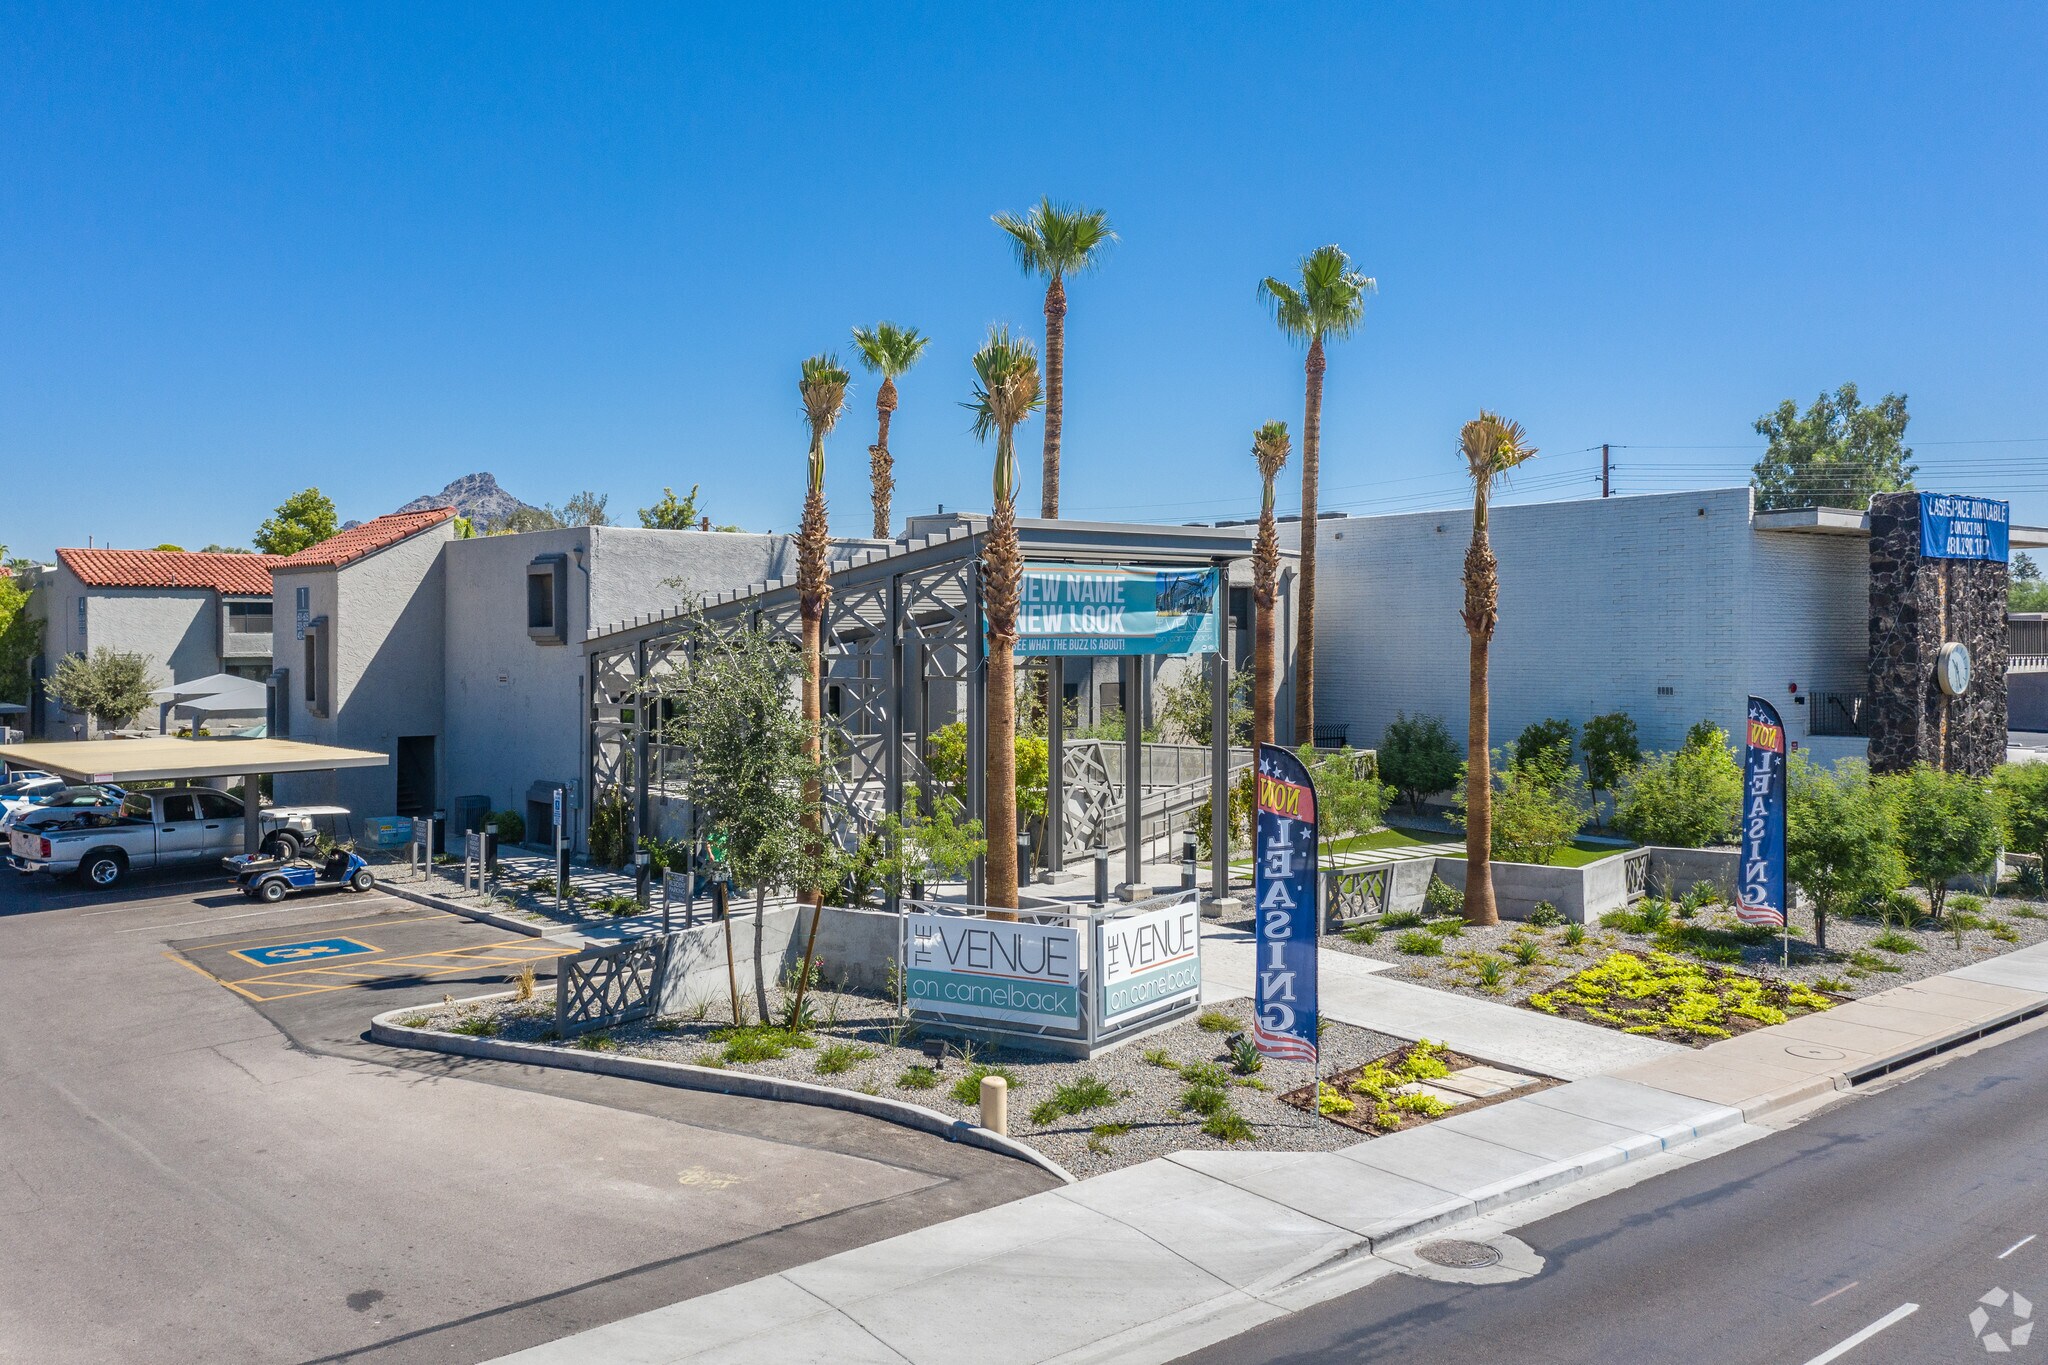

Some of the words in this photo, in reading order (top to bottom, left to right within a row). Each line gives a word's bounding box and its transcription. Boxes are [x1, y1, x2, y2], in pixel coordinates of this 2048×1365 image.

[1971, 501, 2006, 522] AVAILABLE
[1950, 521, 1974, 535] CONTACT
[1017, 573, 1061, 602] NEW
[1066, 574, 1126, 603] NAME
[1016, 604, 1063, 633] NEW
[1069, 605, 1126, 633] LOOK
[1165, 616, 1213, 631] VENUE
[1029, 638, 1051, 651] WHAT
[1053, 639, 1067, 651] THE
[1069, 639, 1089, 651] BUZZ
[1090, 639, 1097, 651] IS
[1098, 638, 1125, 651] ABOUT!
[914, 924, 932, 966] THE
[938, 925, 1069, 978] VENUE
[1108, 933, 1119, 980] THE
[1122, 912, 1195, 969] VENUE
[912, 978, 938, 997] on
[945, 979, 1068, 1014] camelback
[1111, 990, 1128, 1011] on
[1130, 964, 1198, 1005] camelback
